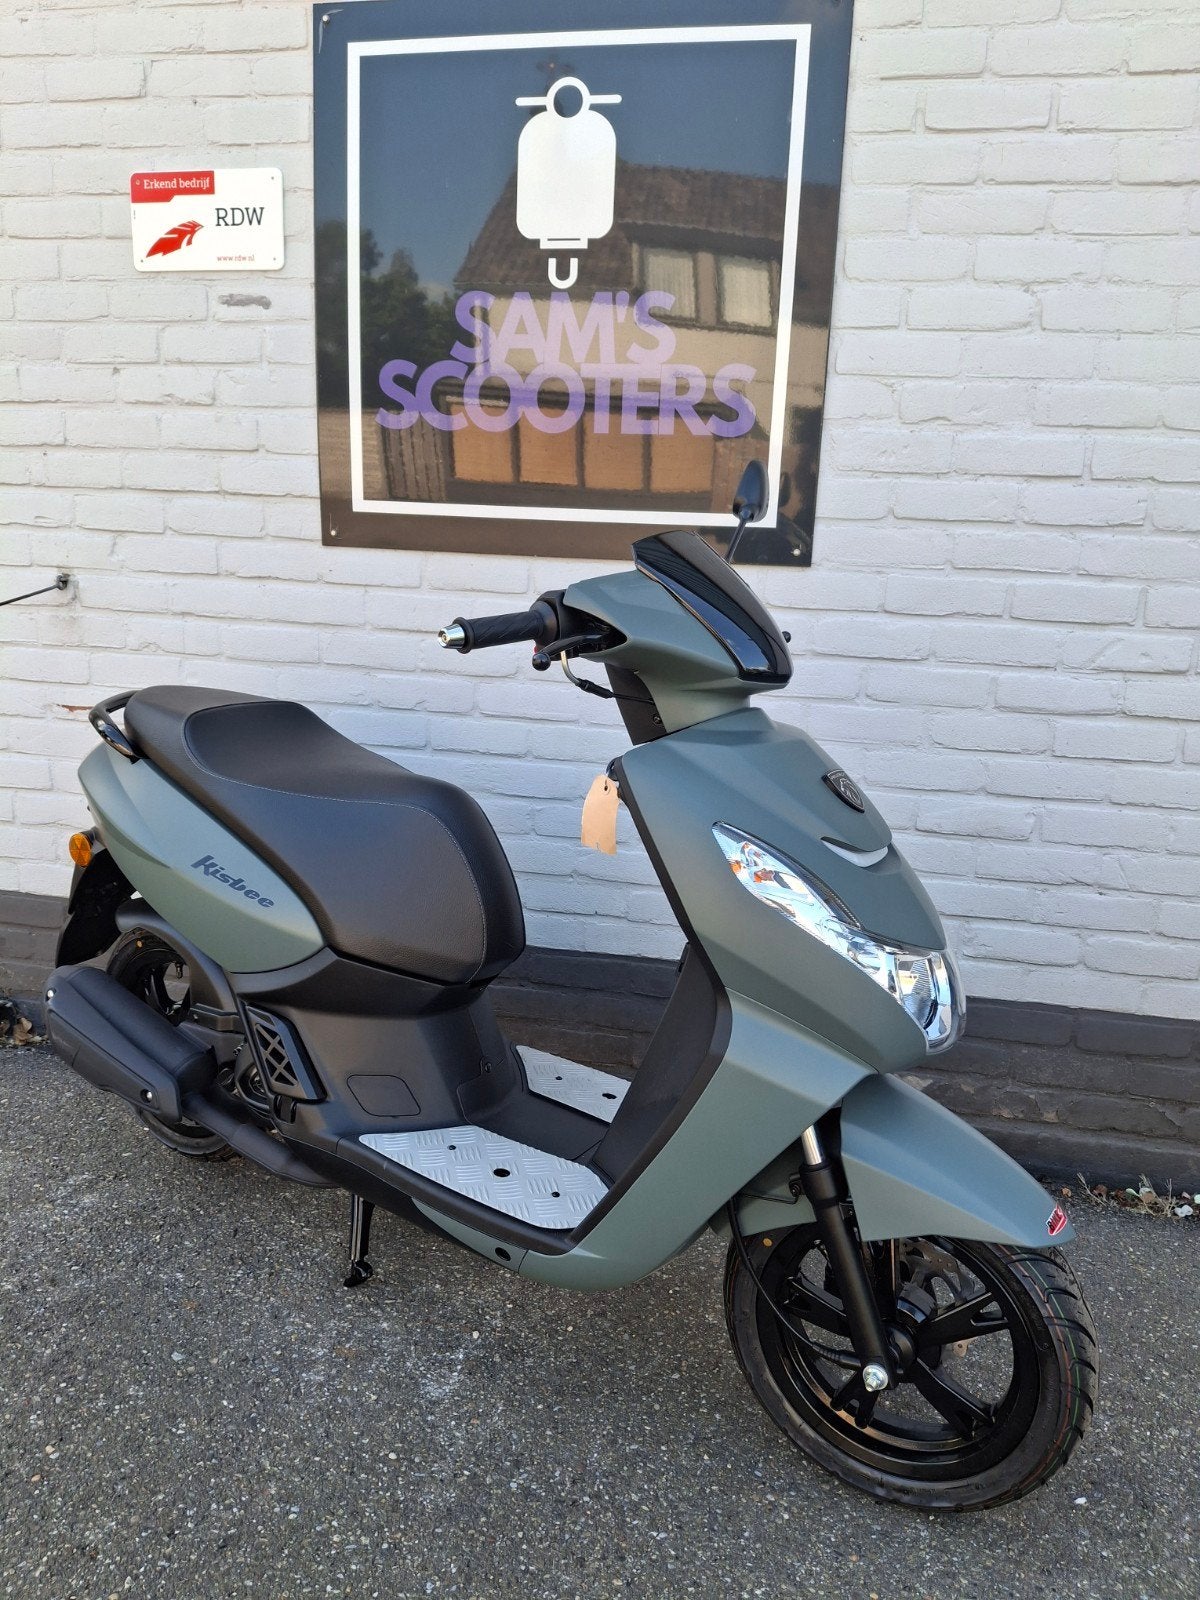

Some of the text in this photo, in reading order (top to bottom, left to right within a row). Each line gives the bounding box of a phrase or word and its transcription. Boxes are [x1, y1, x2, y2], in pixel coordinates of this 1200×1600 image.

[143, 177, 210, 190] Erkend bedrijf
[214, 207, 265, 227] RDW
[216, 254, 255, 262] www.rdw.nl
[449, 290, 677, 365] SAM'S
[374, 359, 758, 438] SCOOTERS
[190, 854, 275, 908] Kisbee
